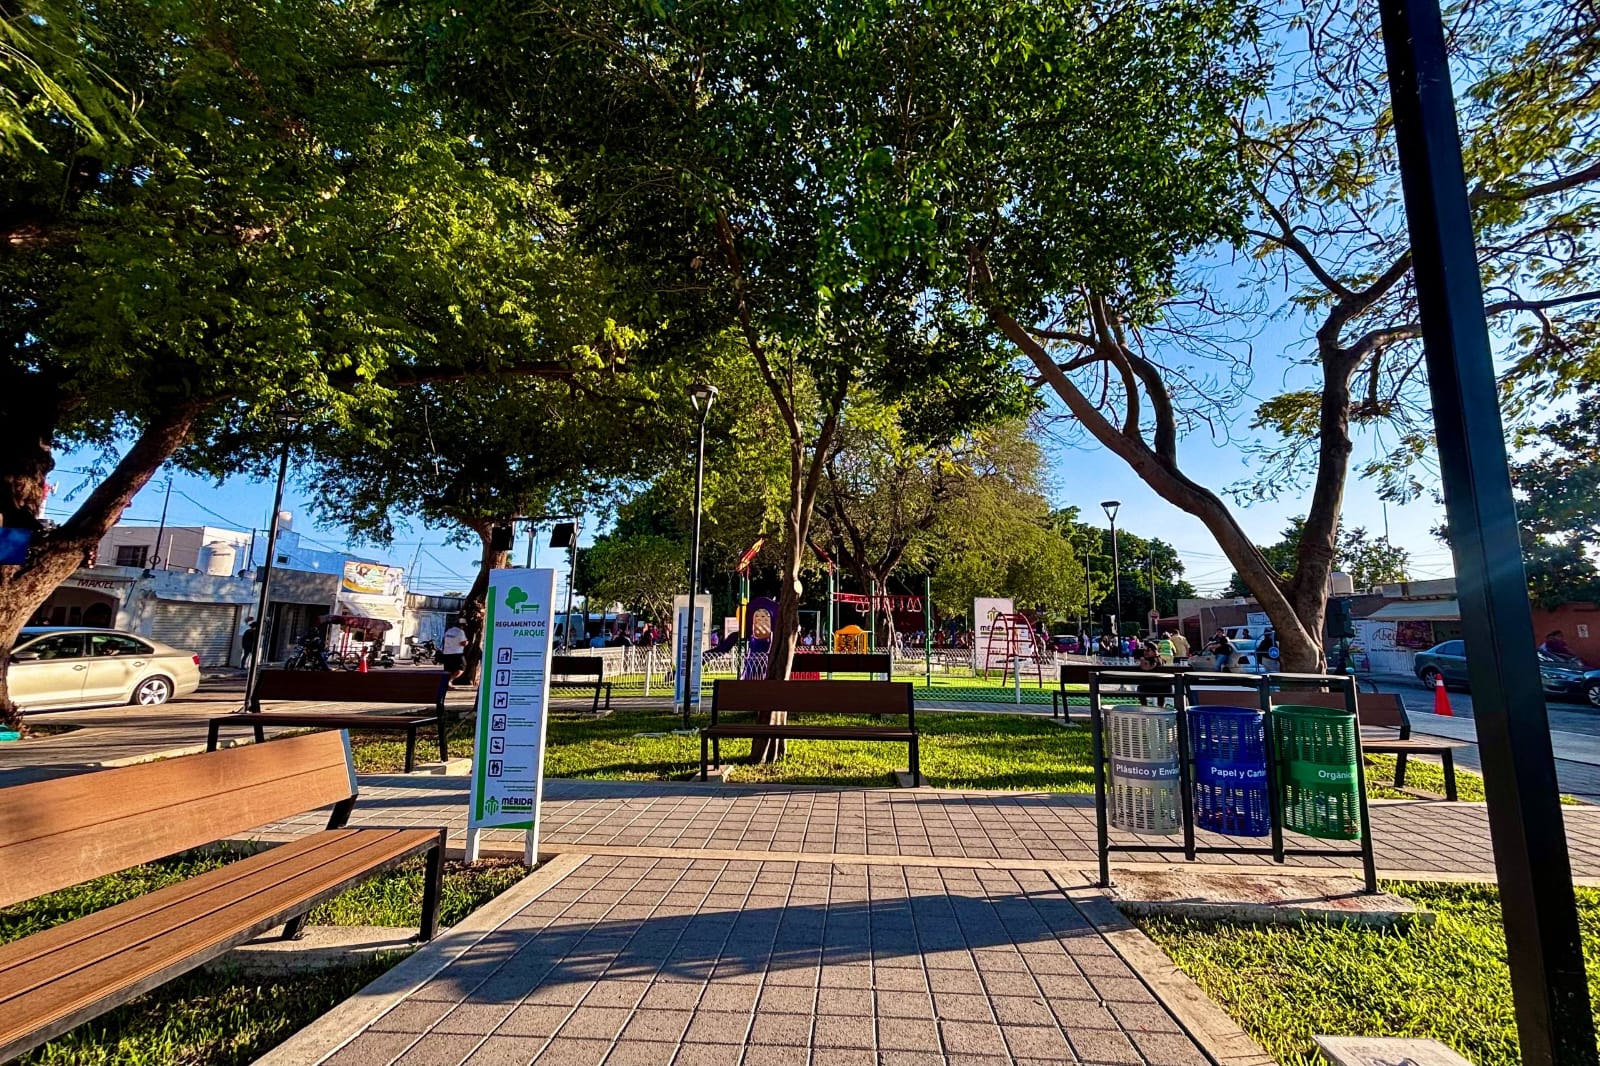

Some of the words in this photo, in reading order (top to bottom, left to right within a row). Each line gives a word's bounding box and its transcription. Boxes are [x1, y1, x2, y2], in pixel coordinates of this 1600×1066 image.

[513, 629, 545, 638] PARQUE
[1116, 763, 1150, 776] Plástico
[1151, 769, 1157, 778] y
[1211, 766, 1236, 778] Papel
[1238, 771, 1245, 779] y
[501, 796, 533, 806] MÉRIDA
